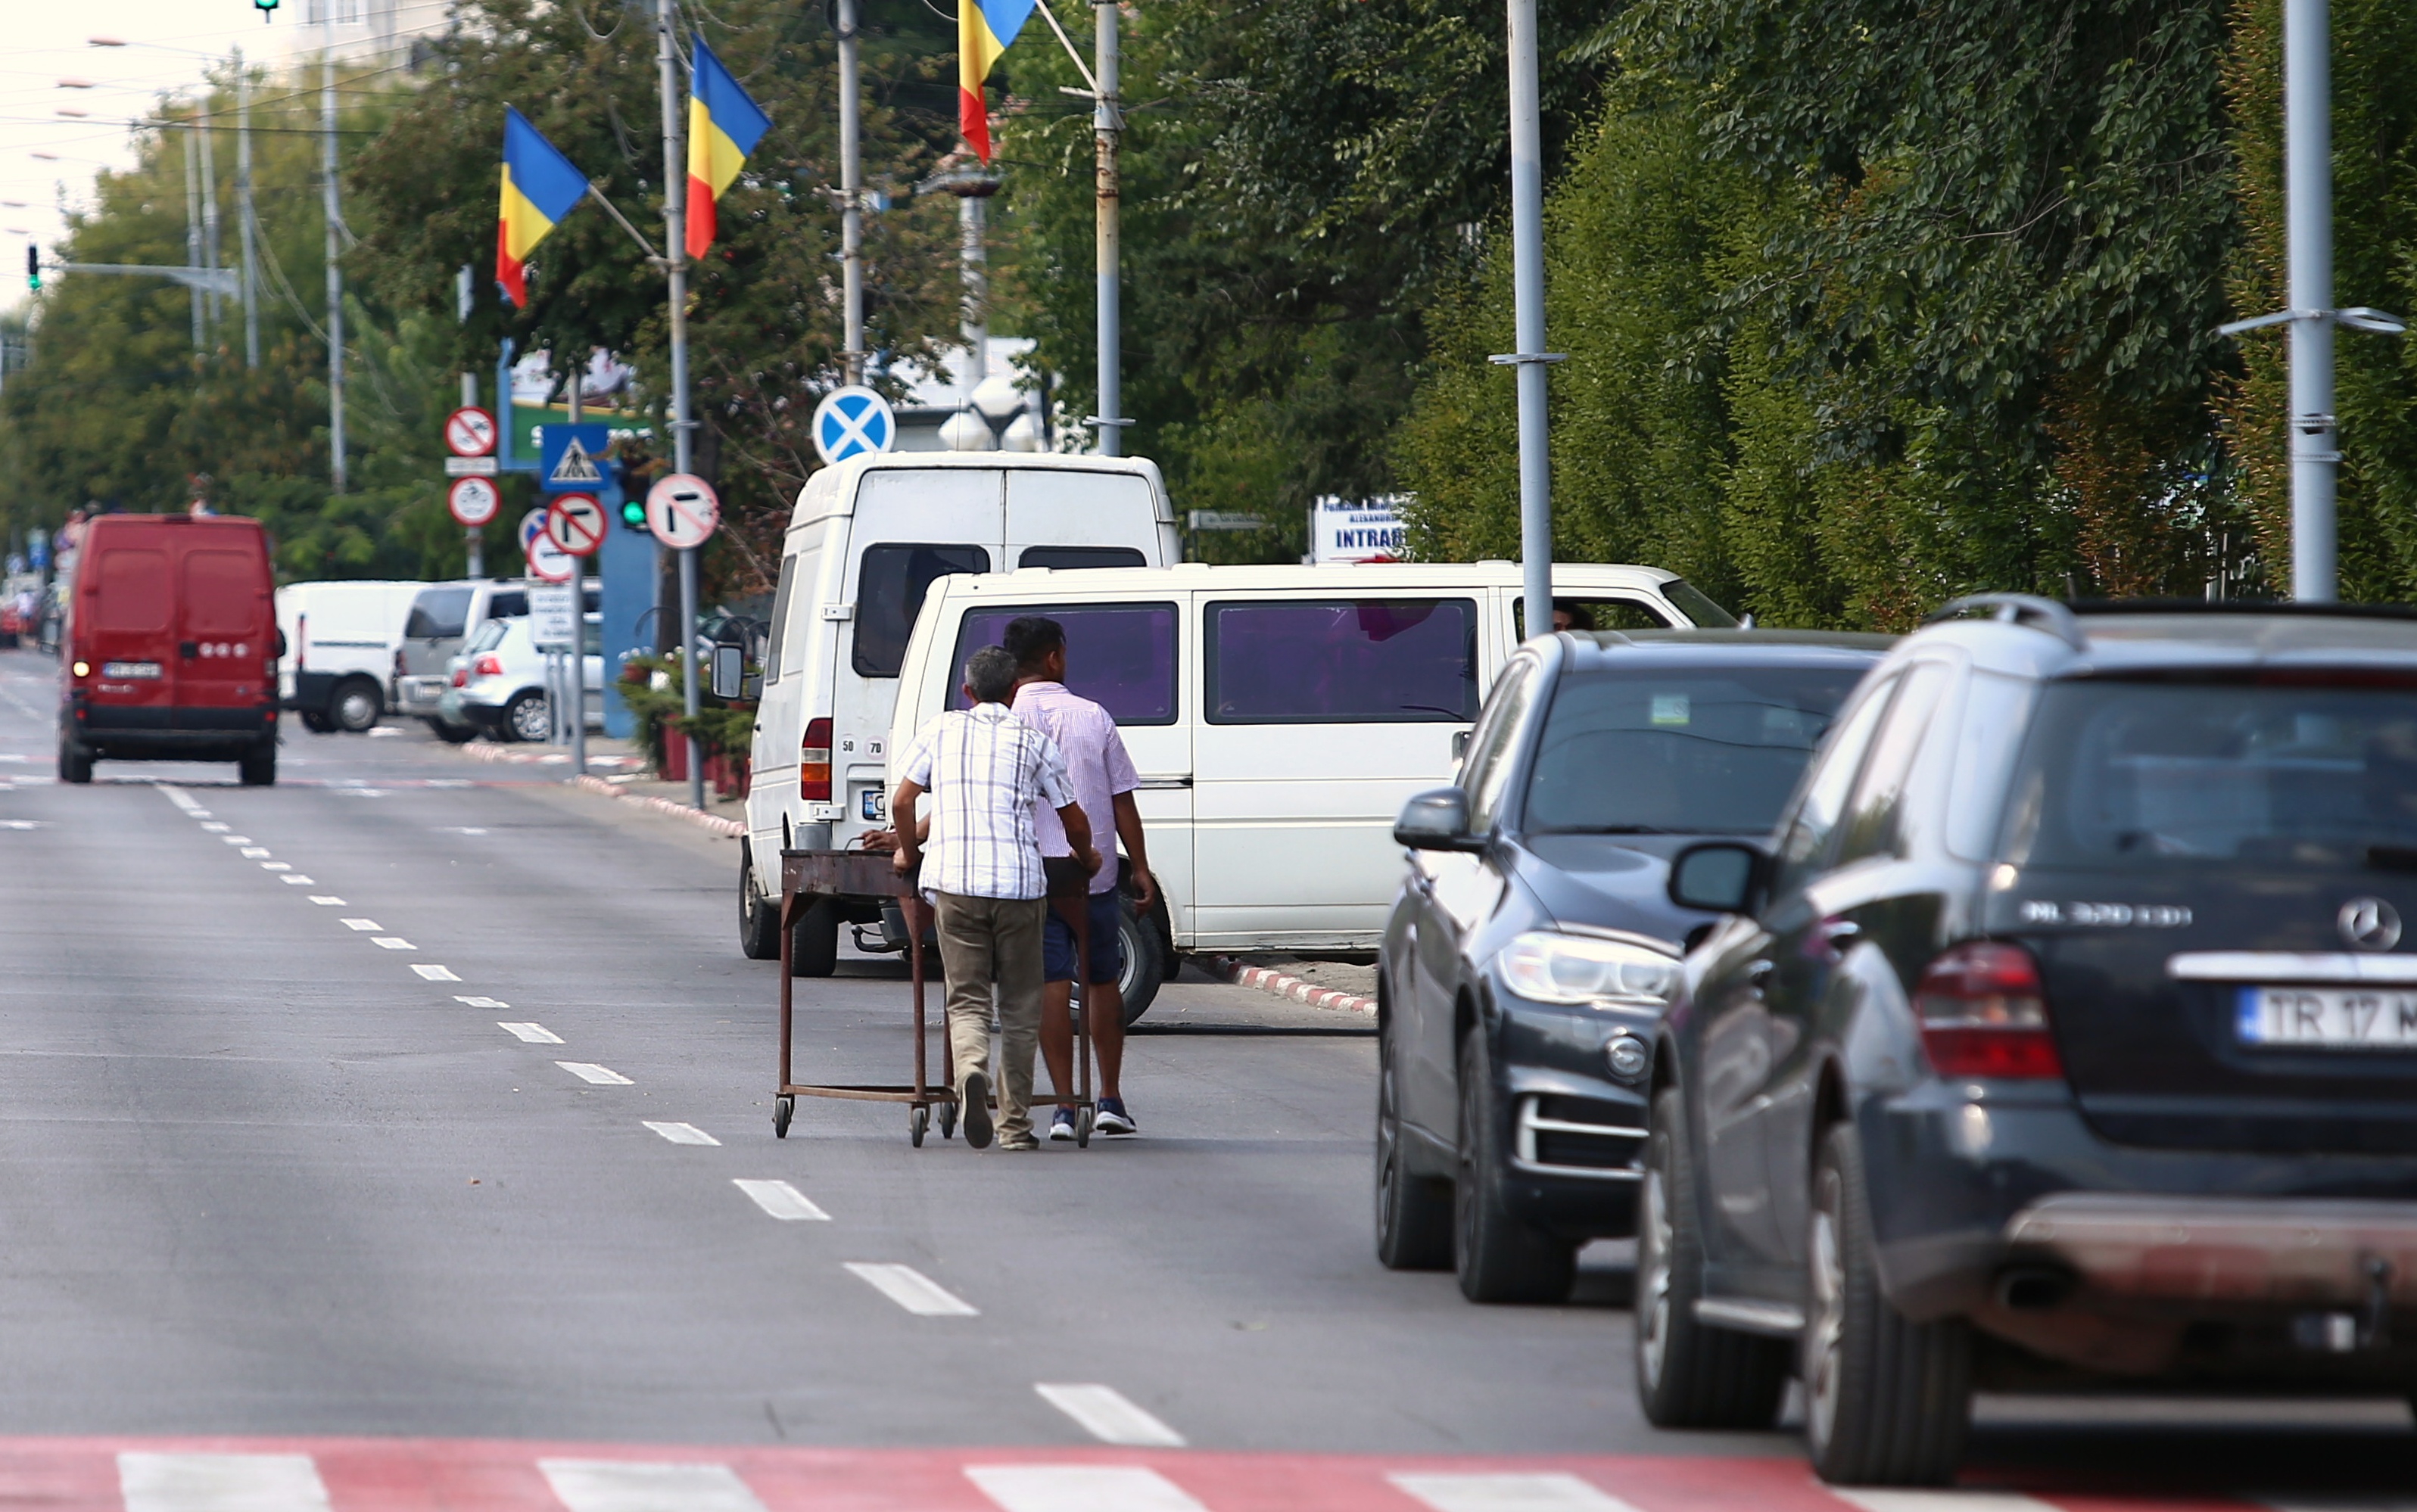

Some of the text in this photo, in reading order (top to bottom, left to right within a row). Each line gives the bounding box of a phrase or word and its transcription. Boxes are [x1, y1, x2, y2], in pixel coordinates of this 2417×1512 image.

[1350, 513, 1397, 523] ALEXANDRI
[843, 740, 854, 751] 50
[870, 742, 881, 753] 70
[2270, 994, 2325, 1040] TR
[2343, 996, 2381, 1041] 17
